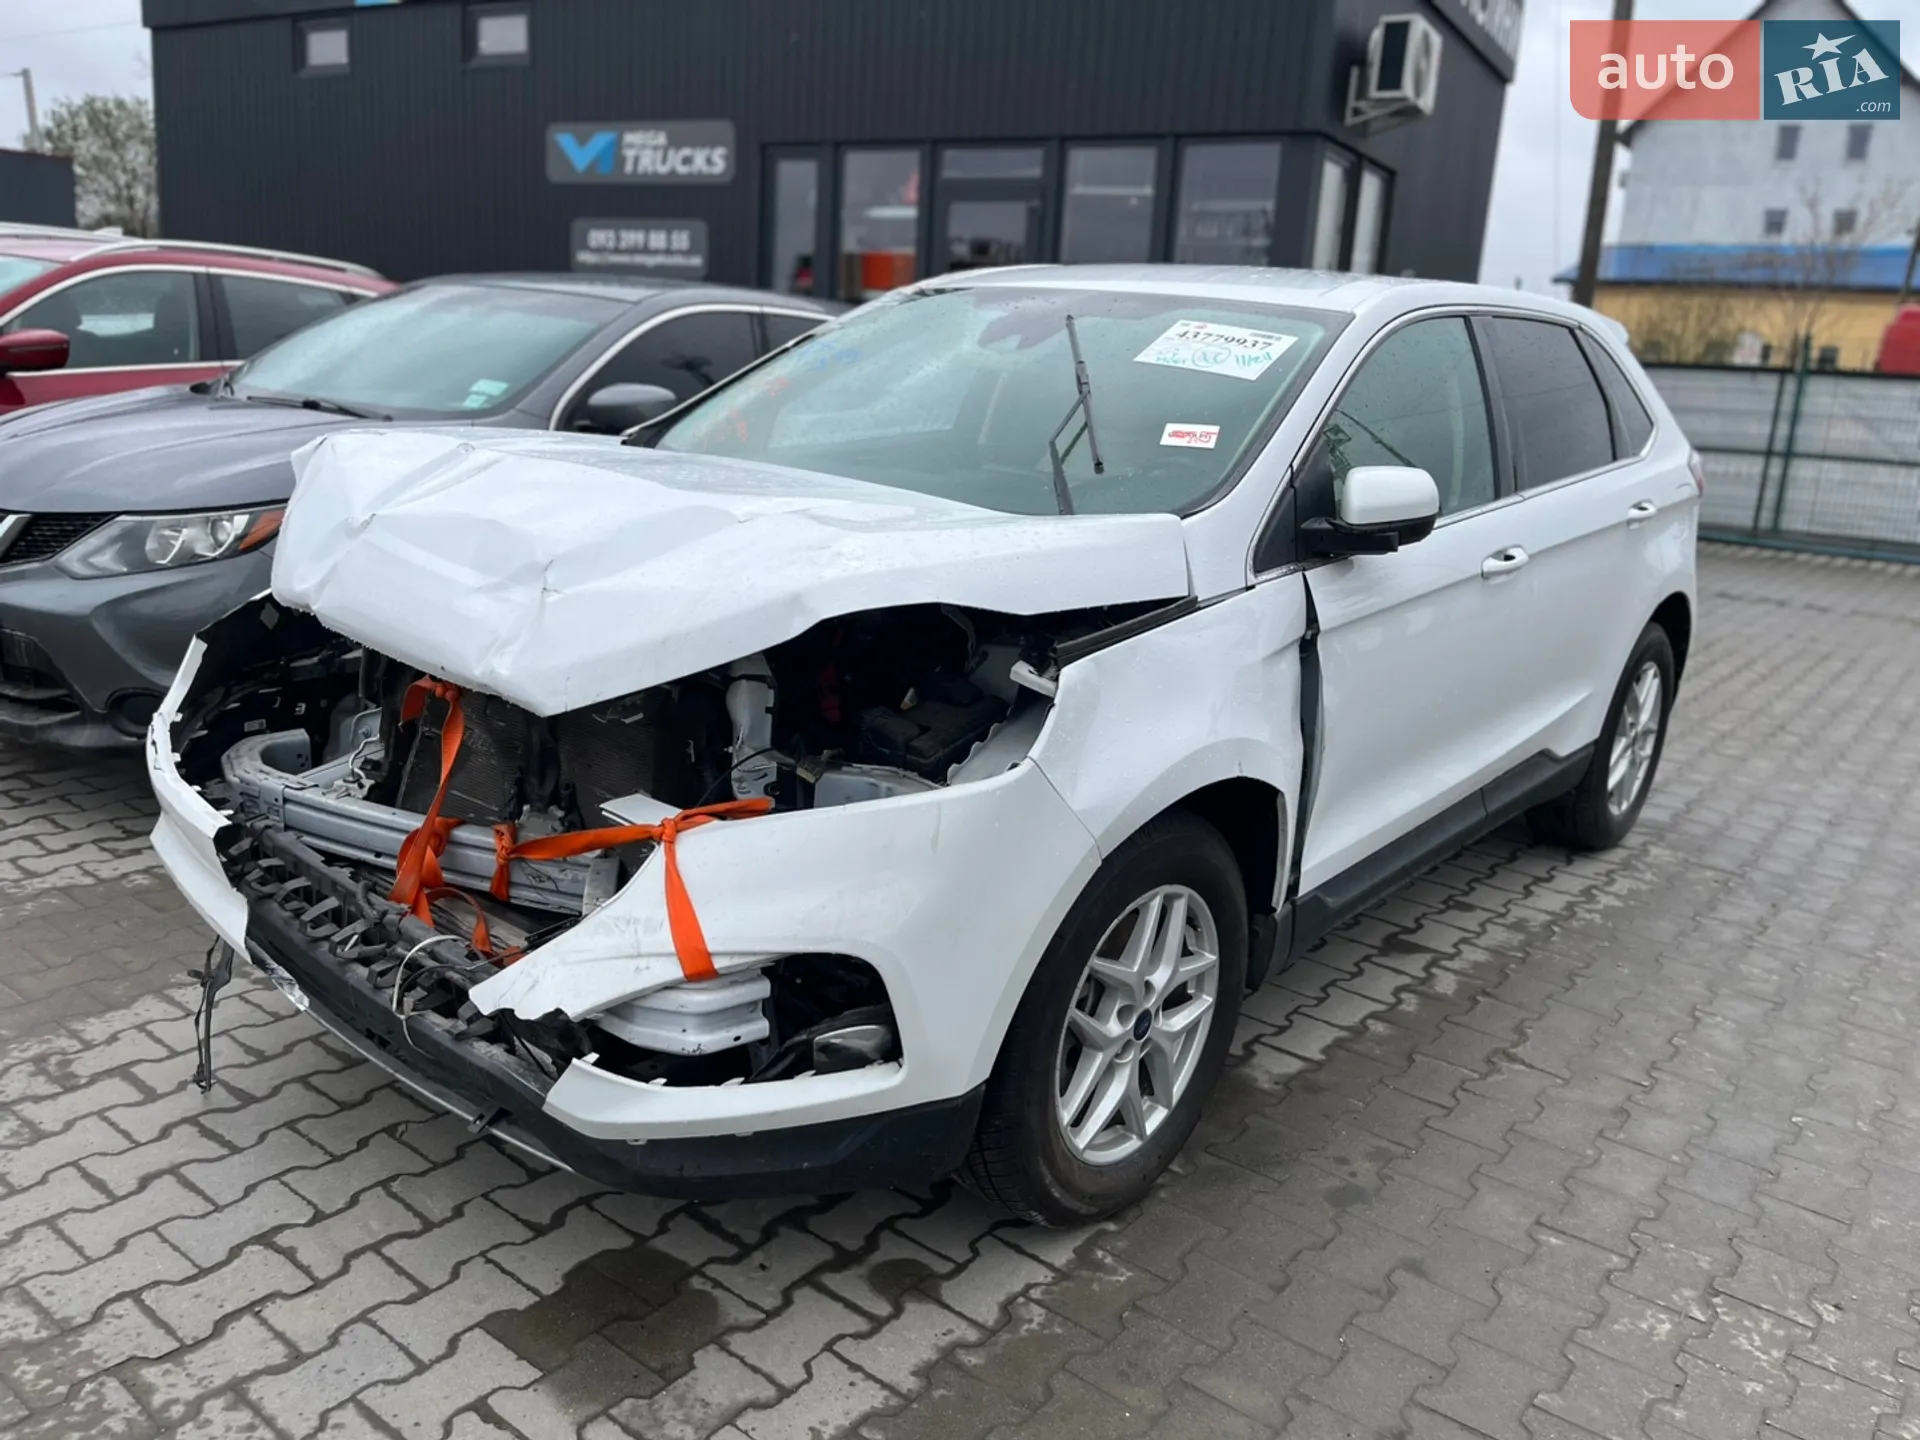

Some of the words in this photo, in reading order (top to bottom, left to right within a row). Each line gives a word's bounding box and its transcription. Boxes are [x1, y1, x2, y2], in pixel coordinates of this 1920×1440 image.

[622, 131, 668, 147] MEGA
[622, 147, 728, 175] TRUCKS
[1176, 329, 1273, 351] 43779937
